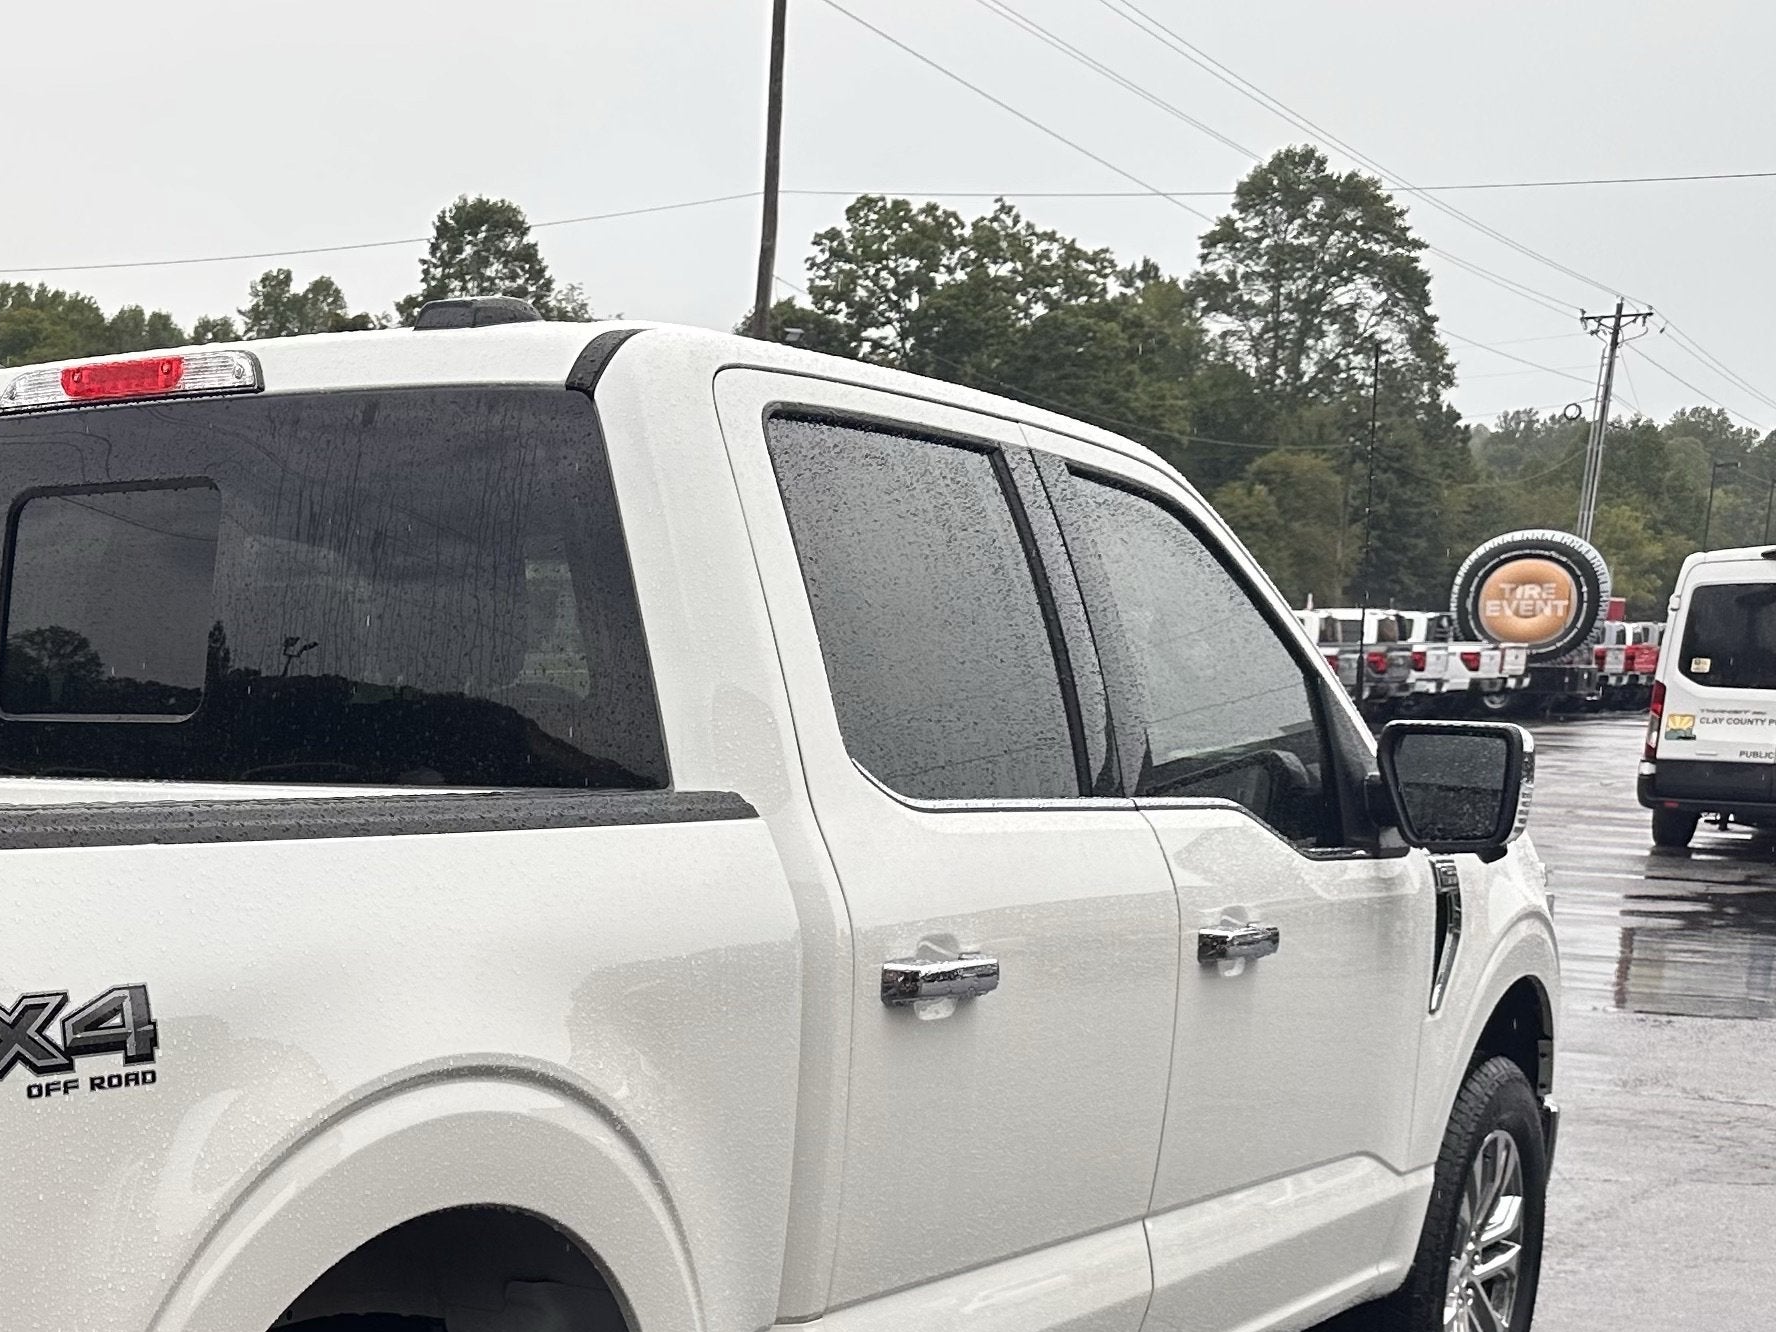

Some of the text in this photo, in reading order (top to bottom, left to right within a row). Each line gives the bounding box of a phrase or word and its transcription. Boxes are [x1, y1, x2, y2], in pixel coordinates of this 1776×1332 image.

[1499, 583, 1557, 599] TIRE
[1485, 600, 1569, 617] EVENT
[1699, 716, 1724, 725] CLAY
[1726, 718, 1766, 726] COUNTY
[1739, 750, 1774, 760] PUBLIC
[26, 1069, 157, 1100] OFF ROAD
